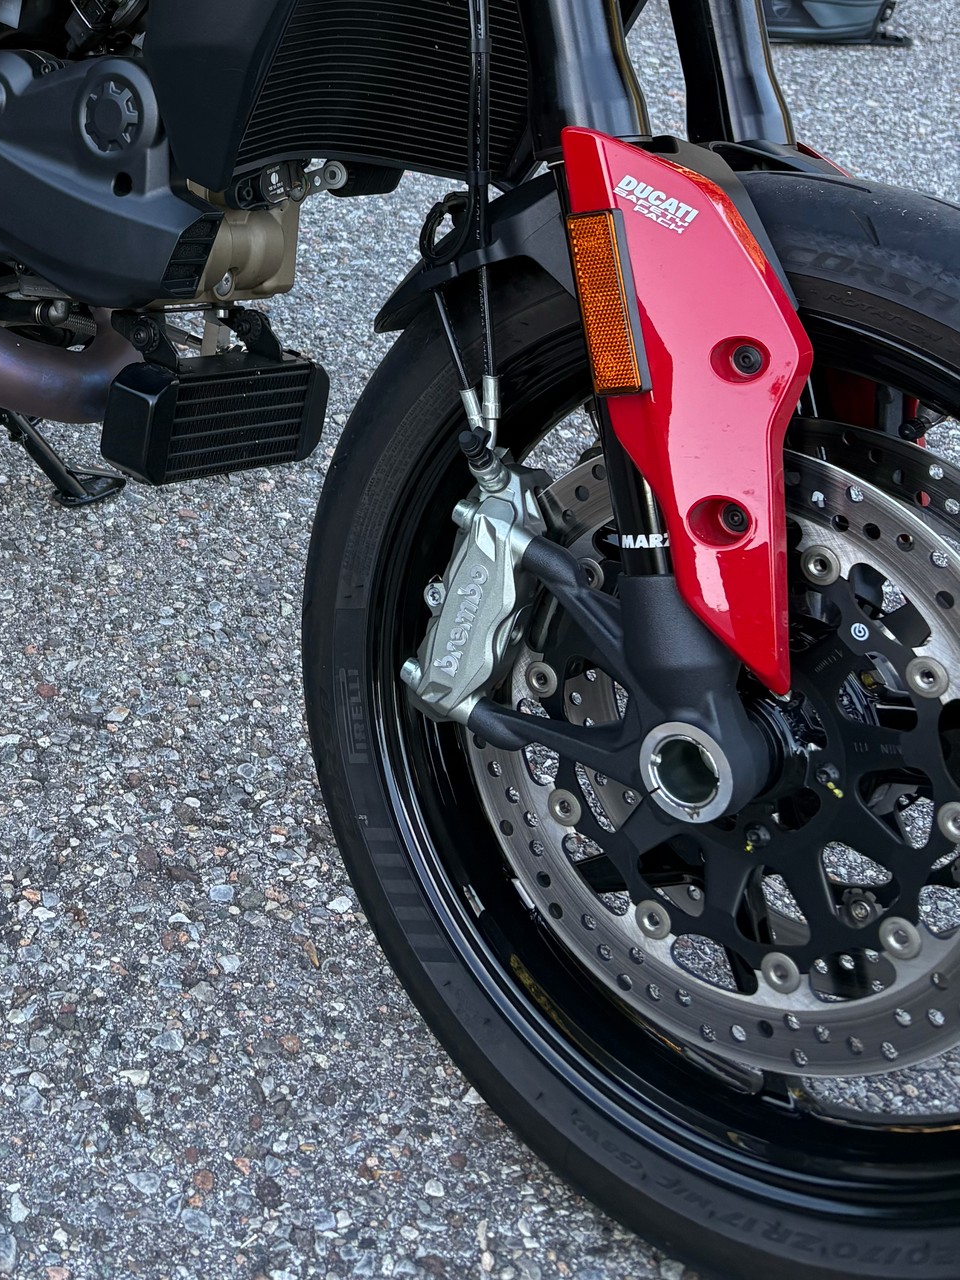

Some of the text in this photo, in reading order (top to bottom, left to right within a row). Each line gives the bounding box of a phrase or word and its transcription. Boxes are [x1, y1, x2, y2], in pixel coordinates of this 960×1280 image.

[613, 187, 689, 227] SAFETY
[616, 174, 700, 223] DUCATI
[633, 204, 685, 234] PACK
[434, 564, 489, 677] brembo
[339, 668, 370, 765] PIRELLI
